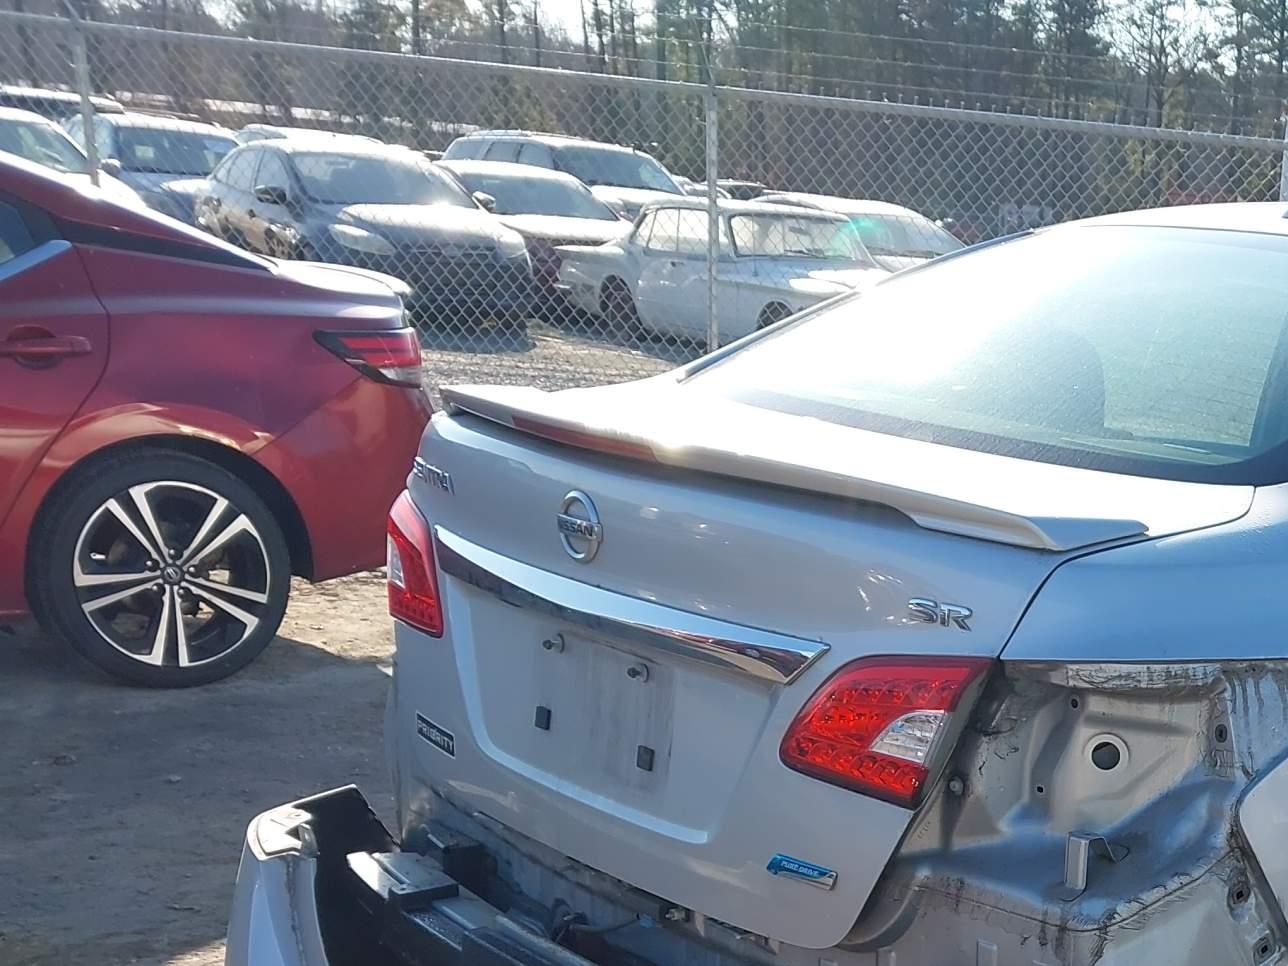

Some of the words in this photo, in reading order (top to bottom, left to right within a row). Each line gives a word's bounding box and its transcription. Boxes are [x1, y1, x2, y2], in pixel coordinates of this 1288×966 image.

[908, 597, 973, 632] SR
[417, 718, 454, 752] PRIORITY
[780, 860, 799, 871] PURE
